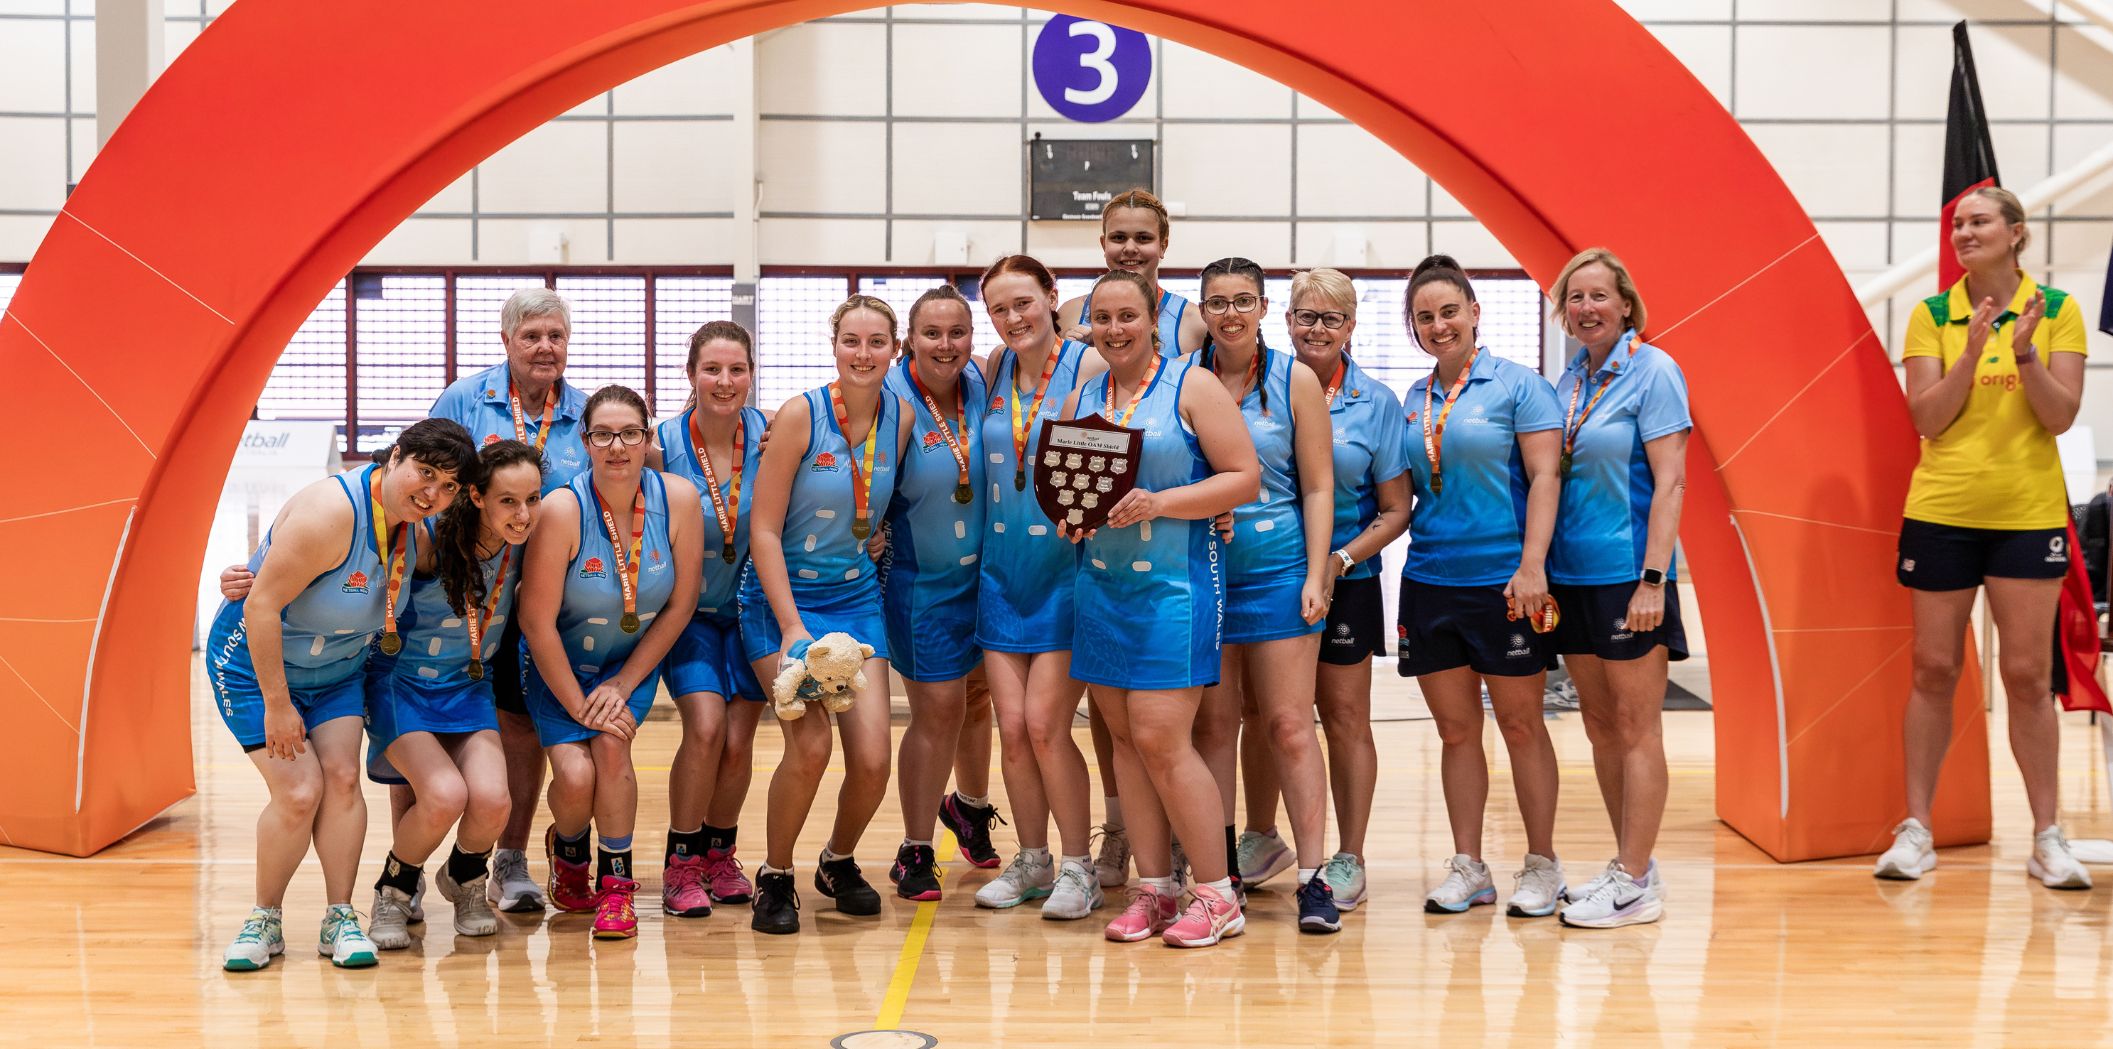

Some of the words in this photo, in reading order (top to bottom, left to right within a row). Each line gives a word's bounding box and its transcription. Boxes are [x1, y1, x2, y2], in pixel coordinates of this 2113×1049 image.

[1064, 20, 1119, 105] 3
[1073, 191, 1092, 201] Team
[1326, 386, 1336, 405] IELD
[1981, 374, 2017, 391] orig
[512, 396, 523, 425] SHIELD
[925, 395, 943, 422] SHIELD
[1463, 417, 1489, 425] netball
[516, 426, 526, 441] TLE
[939, 421, 957, 449] LITTLE
[1423, 410, 1432, 435] LITTLE
[240, 432, 290, 448] tball
[1425, 435, 1436, 462] MARIE
[560, 460, 581, 468] netball
[697, 447, 712, 476] SHIELD
[951, 446, 967, 472] MARIE
[708, 476, 722, 506] LITTLE
[603, 510, 619, 541] SHIELD
[716, 506, 730, 532] MARIE
[1208, 516, 1217, 537] EW
[614, 542, 626, 571] LITTLE
[1208, 541, 1221, 595] SOUTH
[739, 554, 753, 592] UTH
[880, 549, 895, 594] SOUTH
[621, 572, 632, 600] MARIE
[469, 617, 479, 646] MARIE
[1215, 598, 1223, 651] WALES
[1611, 632, 1634, 641] netball
[1331, 637, 1355, 645] netball
[1507, 647, 1531, 657] netball
